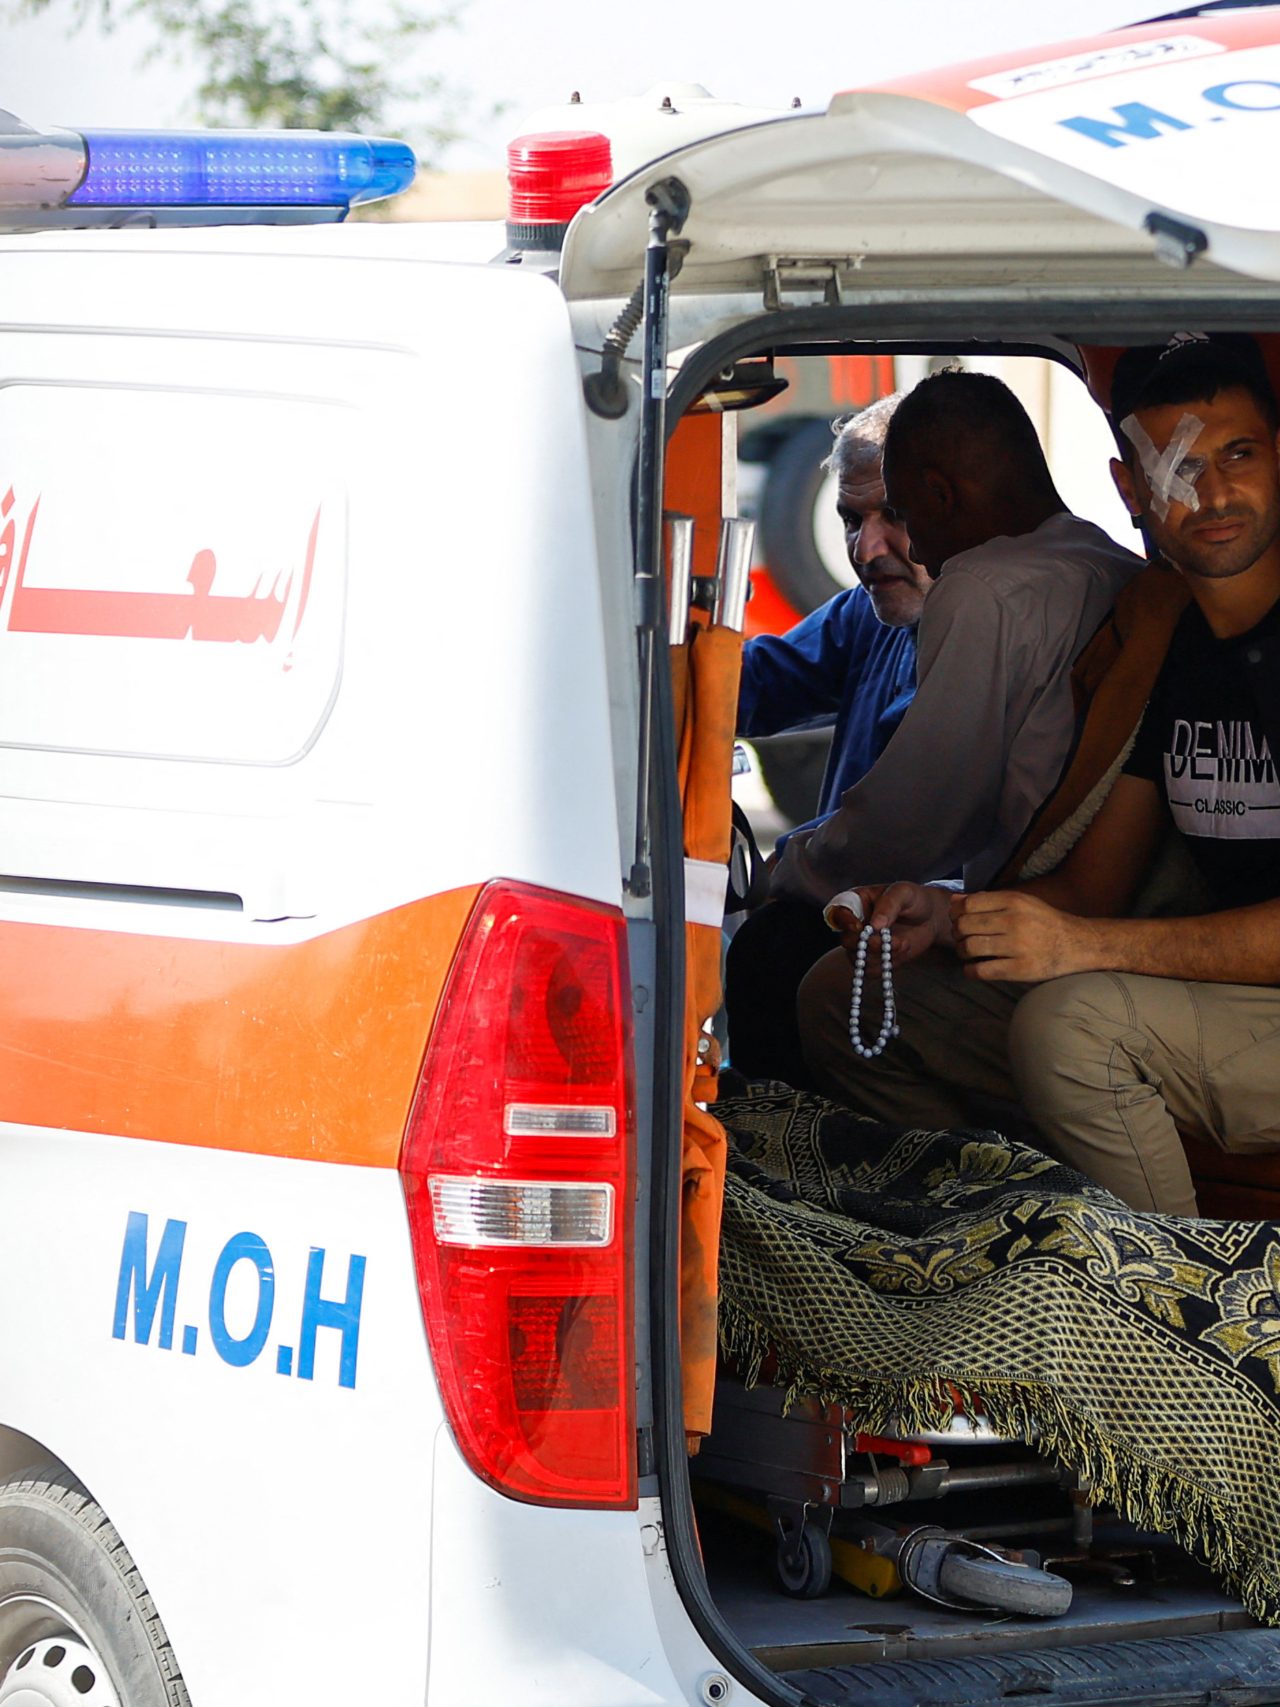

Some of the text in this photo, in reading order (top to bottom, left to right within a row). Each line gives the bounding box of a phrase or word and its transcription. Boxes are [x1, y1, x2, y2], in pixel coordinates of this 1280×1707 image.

[1170, 719, 1275, 783] DENIM
[1194, 798, 1247, 816] CLASSIC
[112, 1210, 367, 1390] M.O.H
